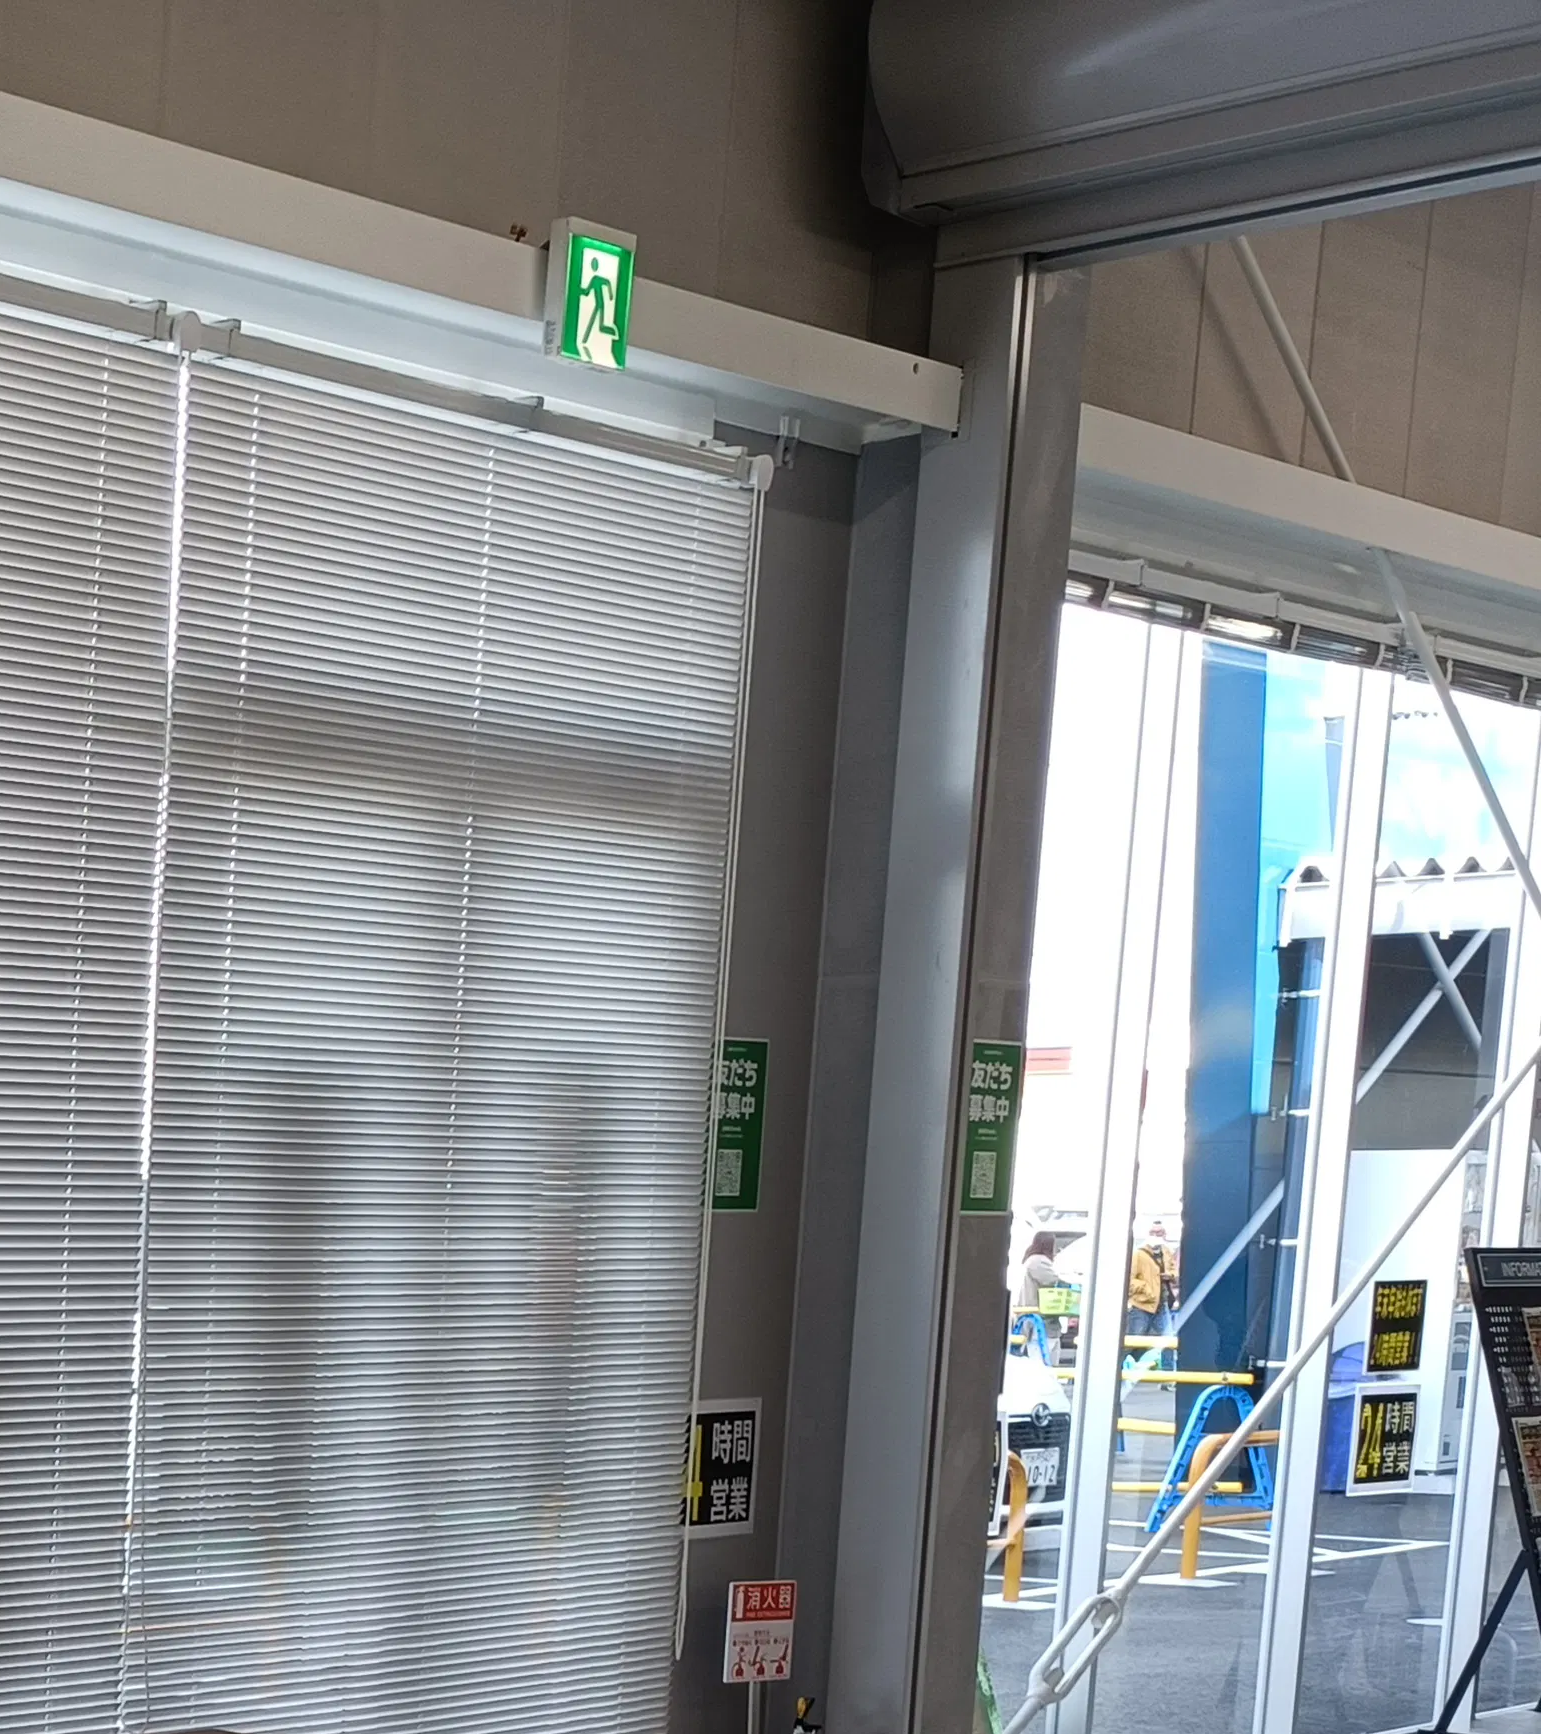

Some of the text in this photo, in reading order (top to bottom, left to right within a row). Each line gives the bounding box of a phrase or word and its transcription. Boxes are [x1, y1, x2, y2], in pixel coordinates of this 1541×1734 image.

[971, 1060, 1013, 1090] 友だち
[968, 1094, 1010, 1123] 募集中
[712, 1420, 753, 1464] 時間
[710, 1477, 748, 1522] 営業
[746, 1585, 792, 1610] 消火器
